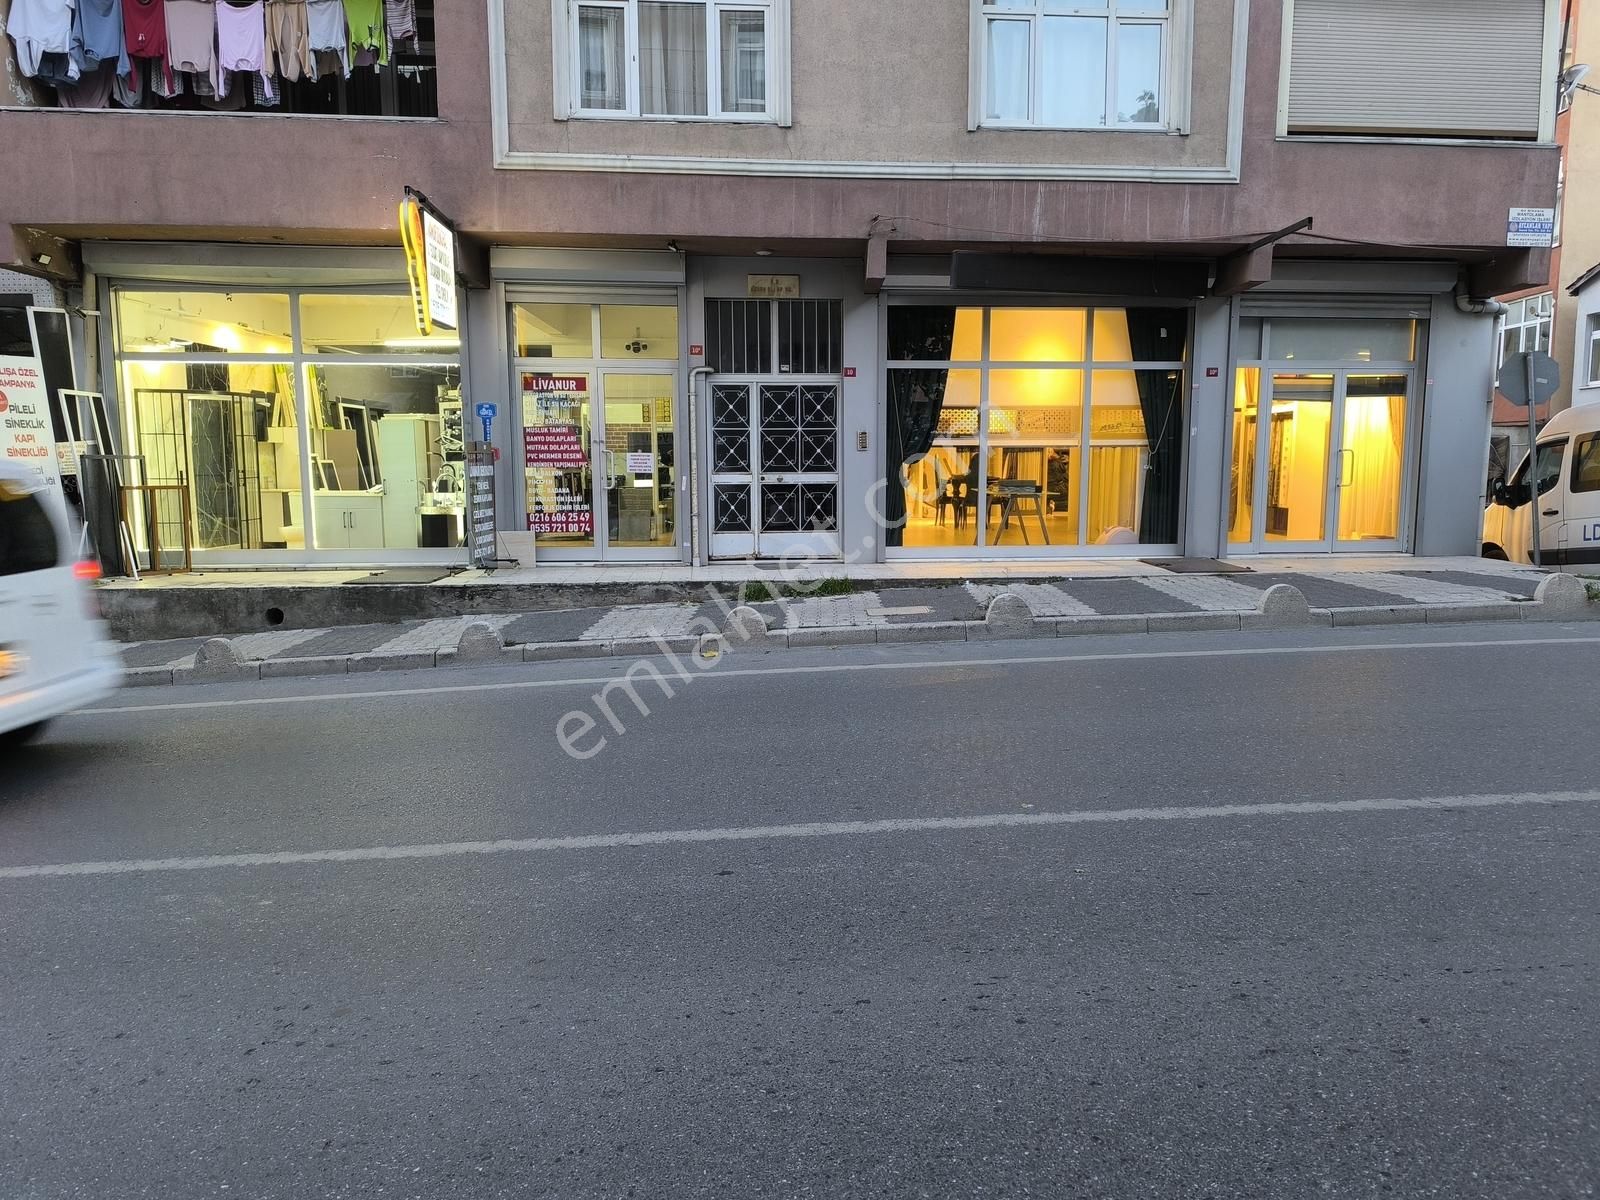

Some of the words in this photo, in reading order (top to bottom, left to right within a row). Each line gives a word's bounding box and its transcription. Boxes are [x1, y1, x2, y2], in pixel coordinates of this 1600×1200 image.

[18, 366, 39, 378] ÖZEL
[533, 378, 577, 390] LİVANUR
[9, 403, 36, 414] PİLELİ
[5, 418, 45, 429] SİNEKLİK
[15, 434, 36, 443] KAPI
[7, 447, 49, 458] SİNEKLİĞİ
[554, 461, 578, 469] YAPIŞMALI
[566, 494, 582, 503] İŞLERİ
[555, 503, 572, 511] DEMİR
[573, 503, 590, 512] İŞLERİ
[529, 512, 549, 522] 0216
[551, 512, 566, 522] 606
[568, 512, 578, 521] 25
[579, 512, 590, 521] 49
[530, 523, 550, 533] 0535
[551, 523, 566, 532] 721
[568, 523, 578, 532] 00
[580, 523, 590, 532] 74
